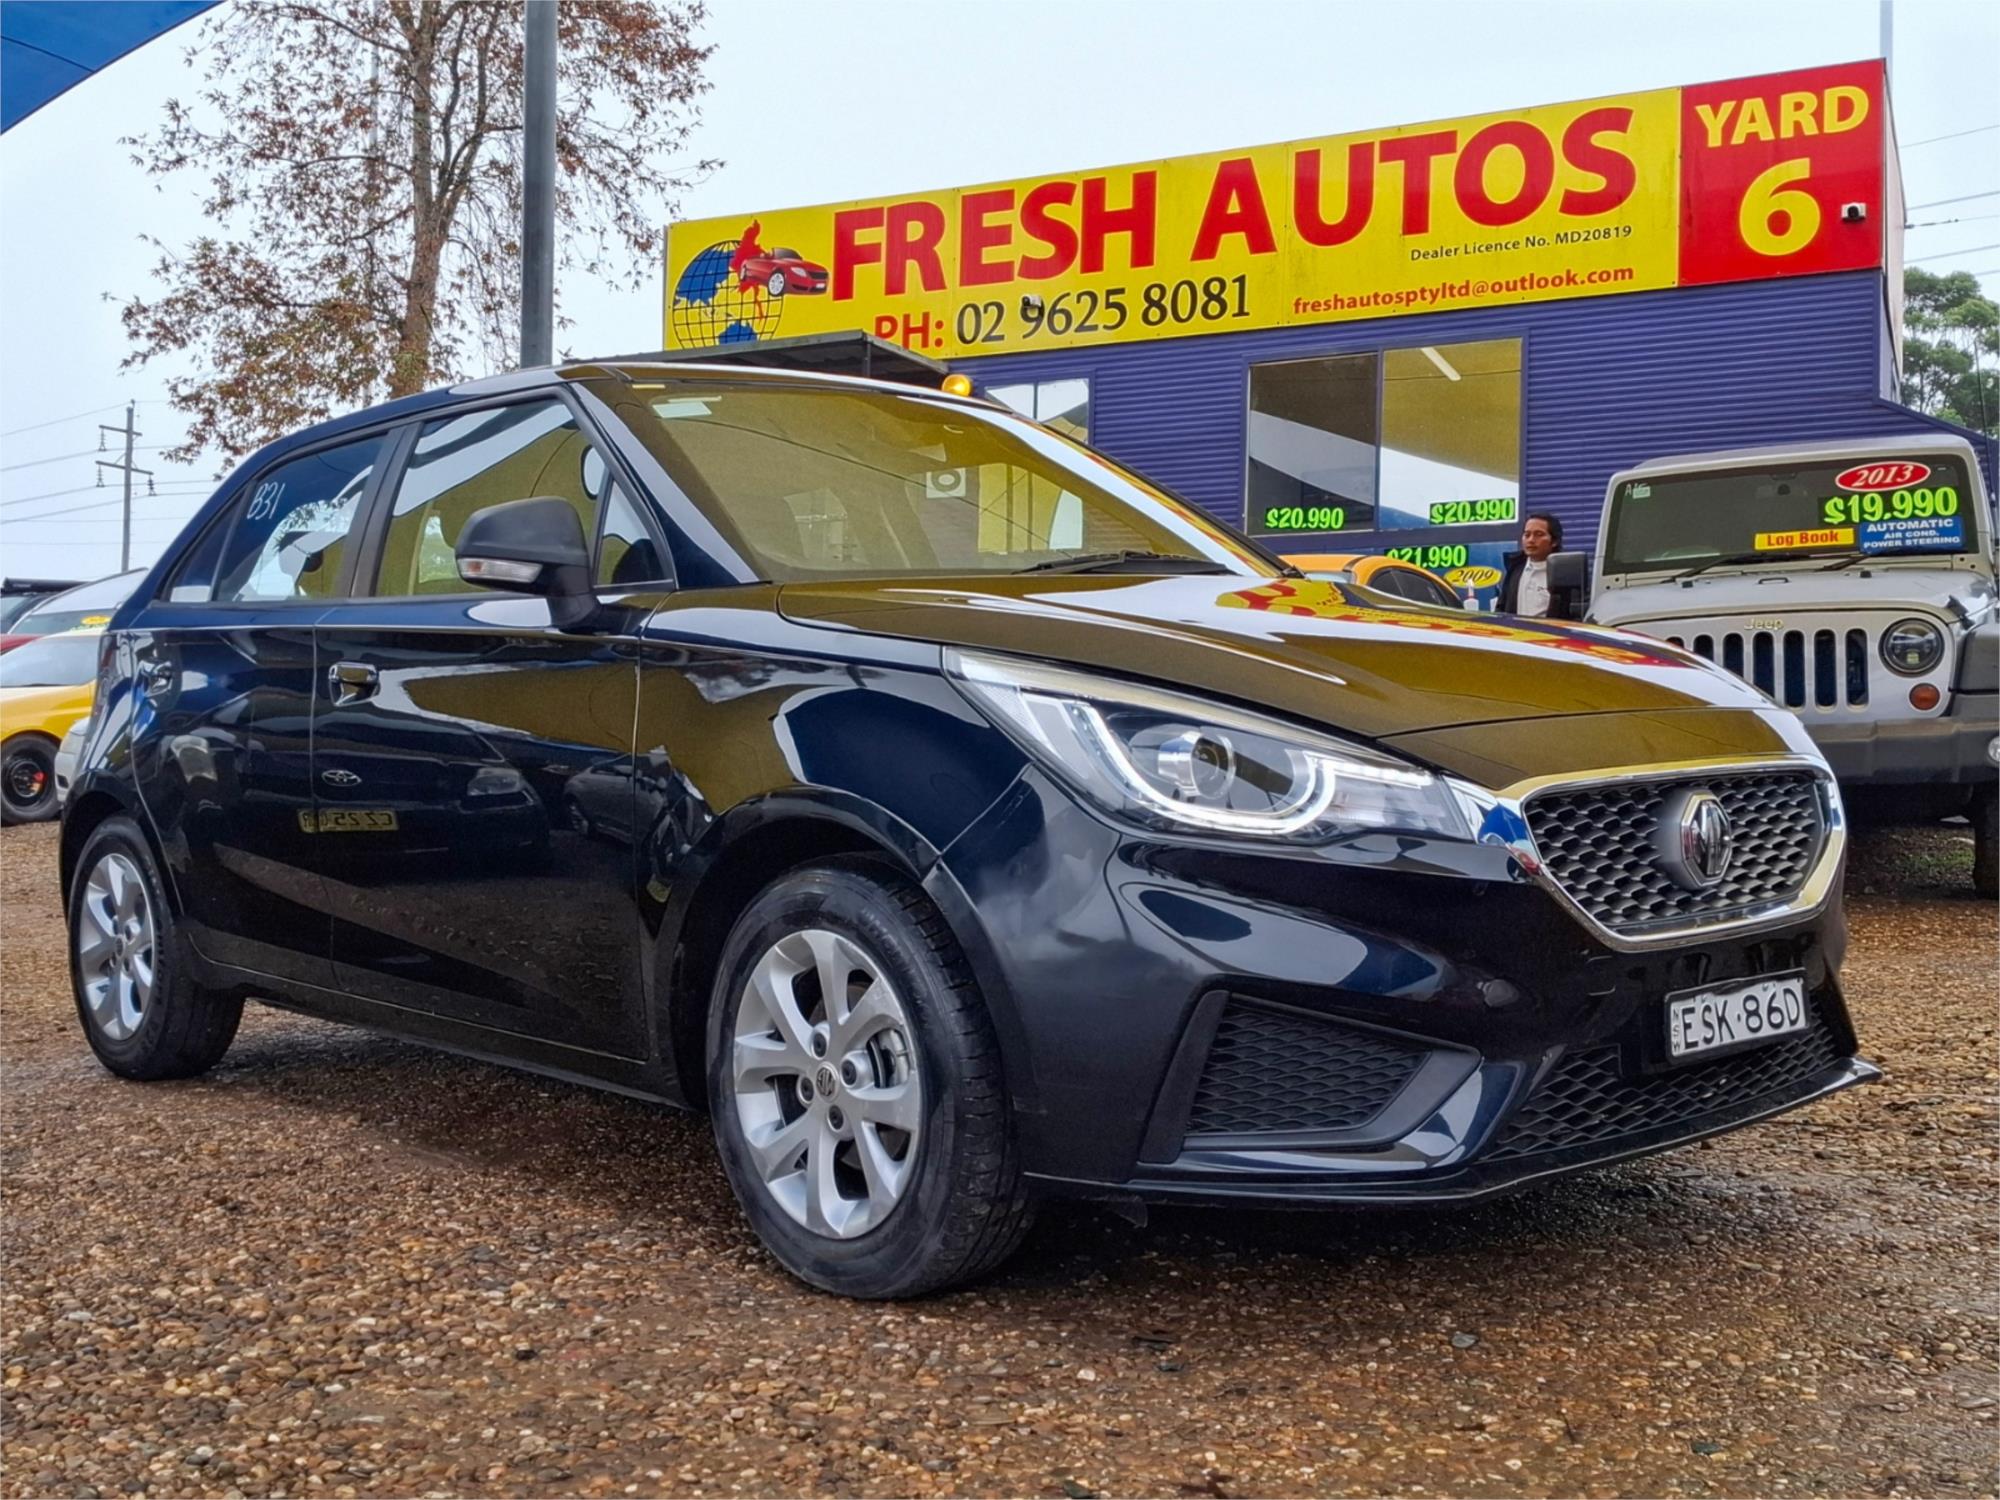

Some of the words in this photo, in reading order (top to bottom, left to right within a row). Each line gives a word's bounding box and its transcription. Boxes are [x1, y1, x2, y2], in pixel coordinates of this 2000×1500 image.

[1695, 86, 1869, 147] YARD
[832, 171, 1157, 301] FRESH
[1190, 106, 1637, 262] AUTOS
[1739, 157, 1820, 256] 6
[1411, 245, 1460, 261] Dealer
[1464, 239, 1520, 255] Licence
[1525, 236, 1550, 249] No.
[1555, 225, 1633, 244] MD20819
[1293, 267, 1634, 314] freshautosptyltd@outlook.com
[875, 312, 944, 349] PH:
[957, 301, 1005, 345] 02
[1020, 287, 1127, 339] 9625
[1141, 274, 1250, 326] 8081
[1851, 465, 1914, 487] 2013
[246, 481, 286, 520] B31
[1430, 498, 1515, 524] $20.990
[1823, 486, 1958, 525] $19.990
[1265, 507, 1344, 529] $20.990
[1867, 518, 1954, 533] AUTOMATIC
[1767, 534, 1794, 548] Log
[1800, 530, 1839, 545] Book
[1863, 540, 1902, 549] POWER
[1906, 537, 1960, 546] STEERING
[1884, 532, 1902, 540] AIR
[1905, 530, 1940, 538] COND.
[1452, 569, 1495, 583] 2009
[1743, 618, 1784, 631] Jeep
